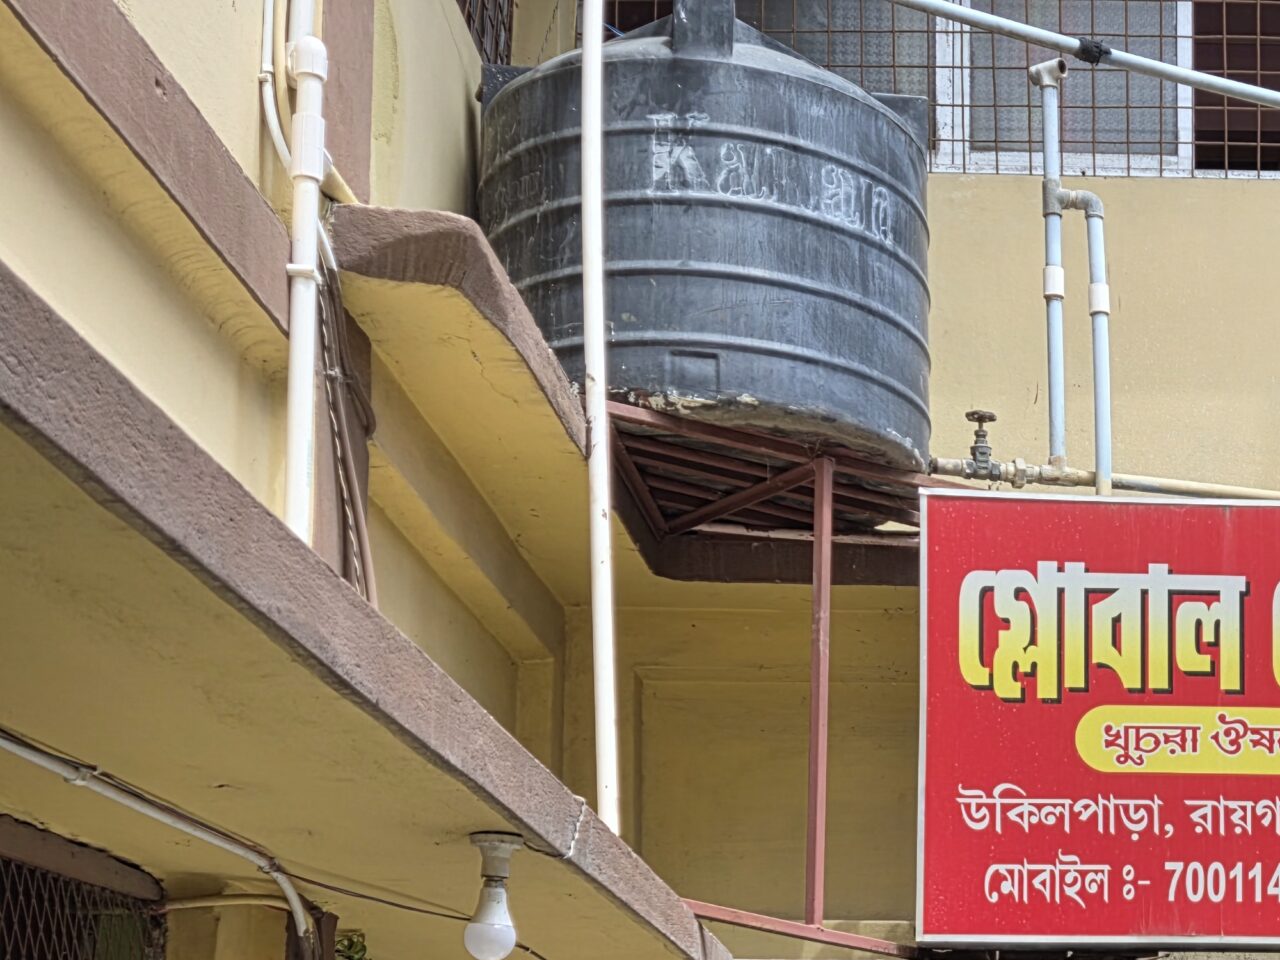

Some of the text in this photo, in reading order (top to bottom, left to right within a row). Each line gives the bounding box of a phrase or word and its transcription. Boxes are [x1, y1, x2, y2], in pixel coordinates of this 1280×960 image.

[959, 560, 1248, 703] গ্লোবাল
[1103, 723, 1201, 766] খুচরা
[956, 783, 1174, 841] উকিলপাড়া,
[984, 849, 1111, 909] মোবাইল
